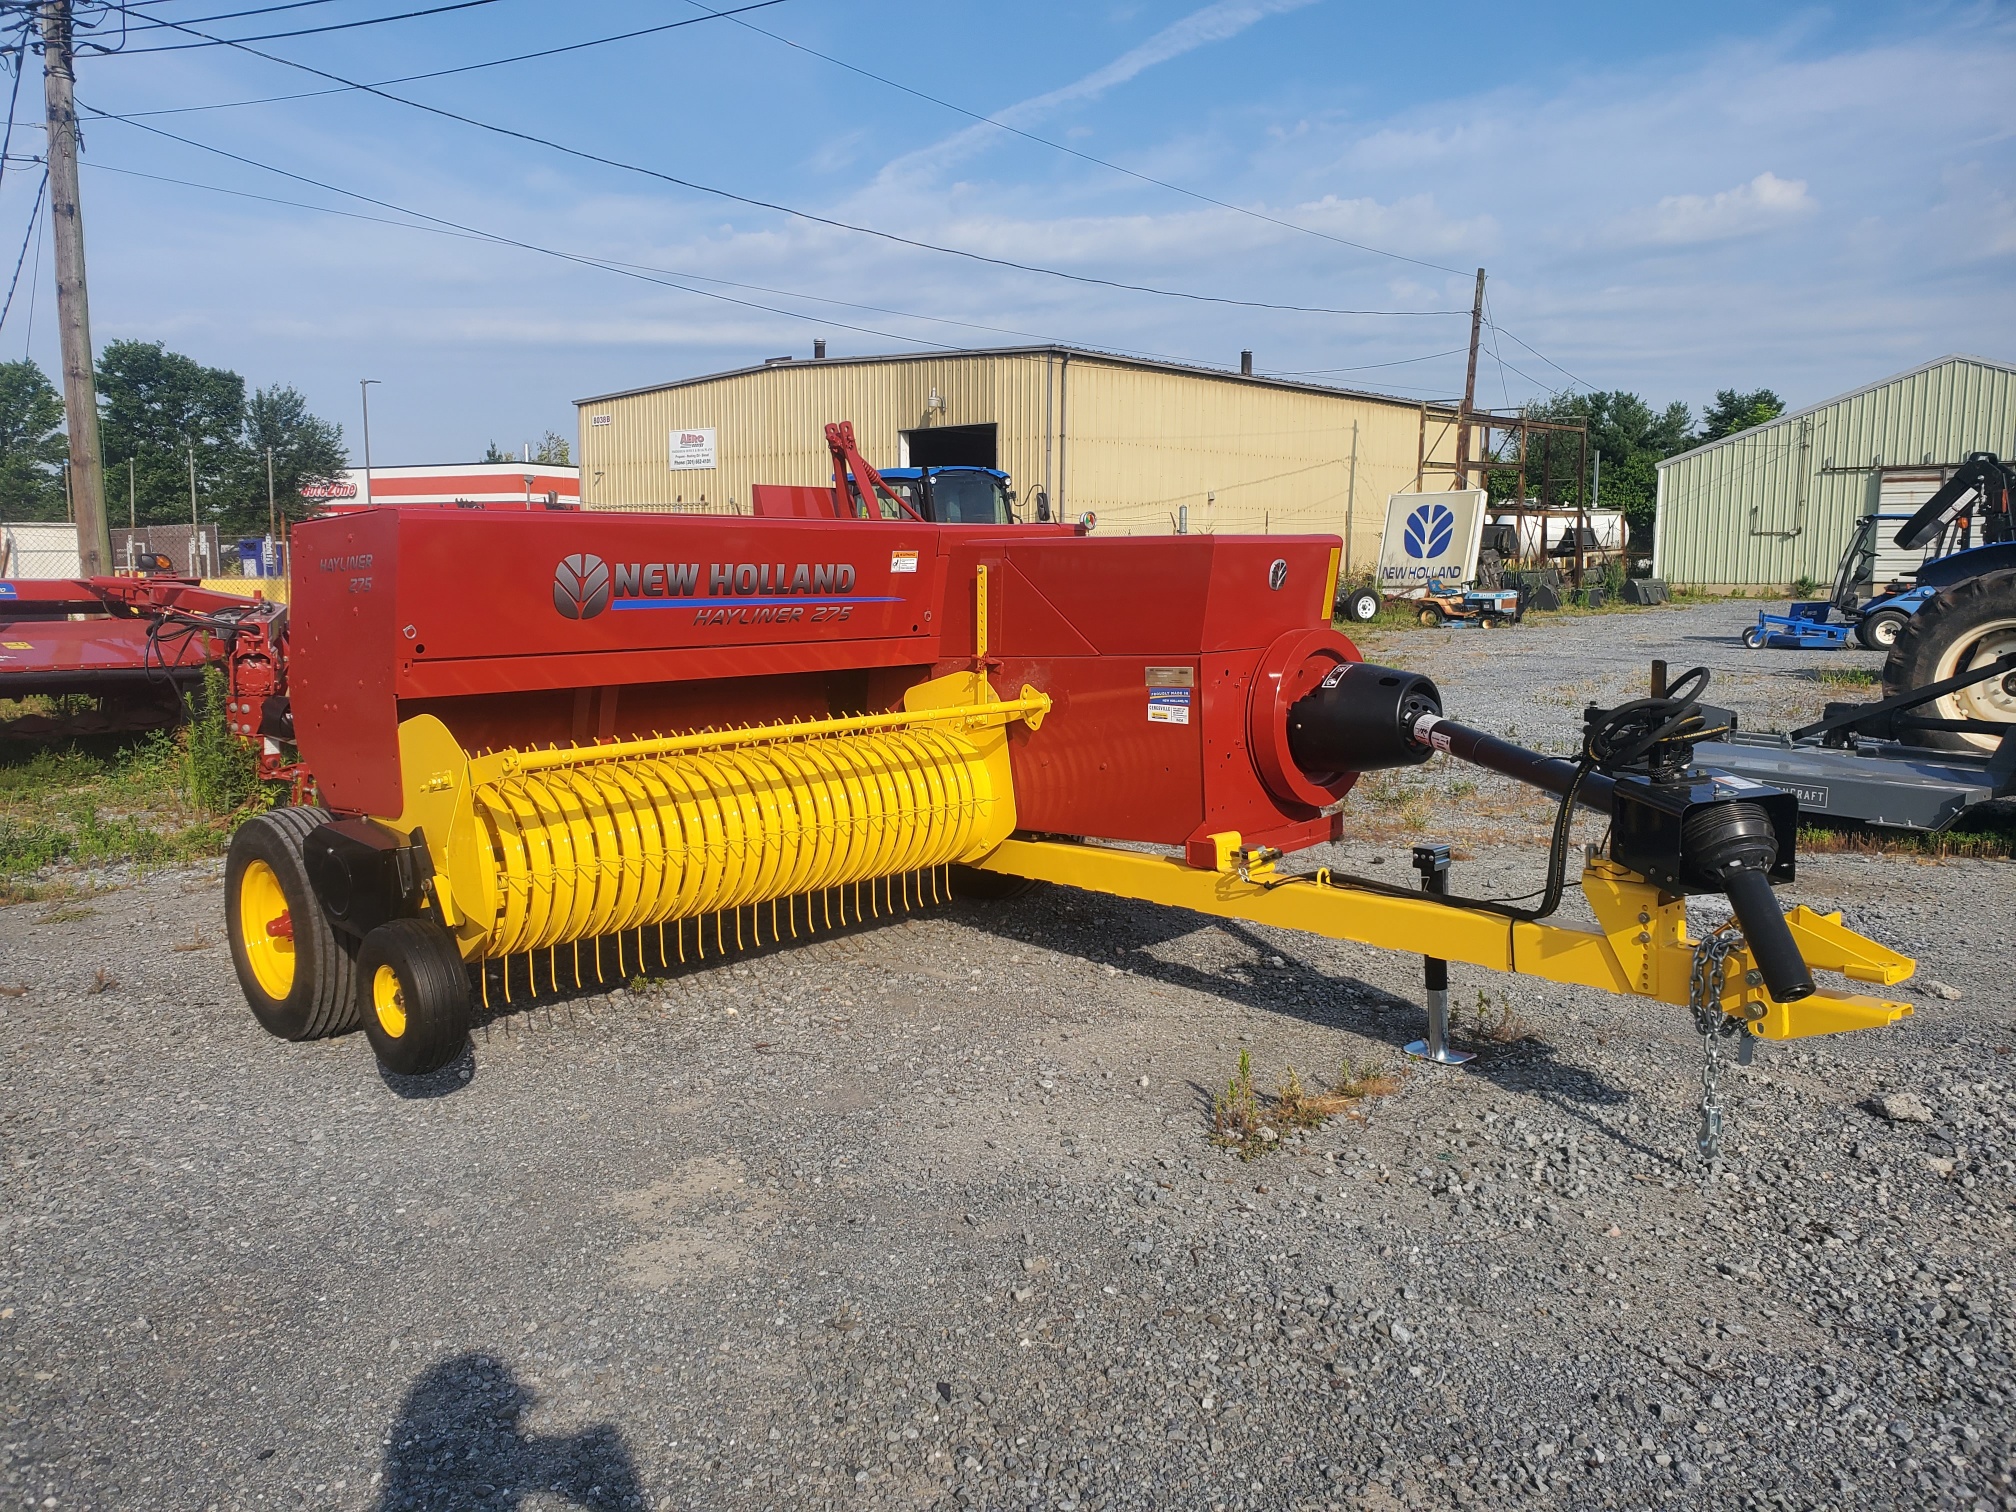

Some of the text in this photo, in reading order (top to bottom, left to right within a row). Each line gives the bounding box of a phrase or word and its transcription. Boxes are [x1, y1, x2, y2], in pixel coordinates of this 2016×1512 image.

[680, 434, 704, 444] AERO
[320, 554, 373, 573] HAYLINER
[613, 563, 856, 597] NEW HOLLAND
[1382, 566, 1461, 579] NEW HOLLAND
[349, 577, 373, 592] 275
[692, 606, 854, 627] HAYLINER 275
